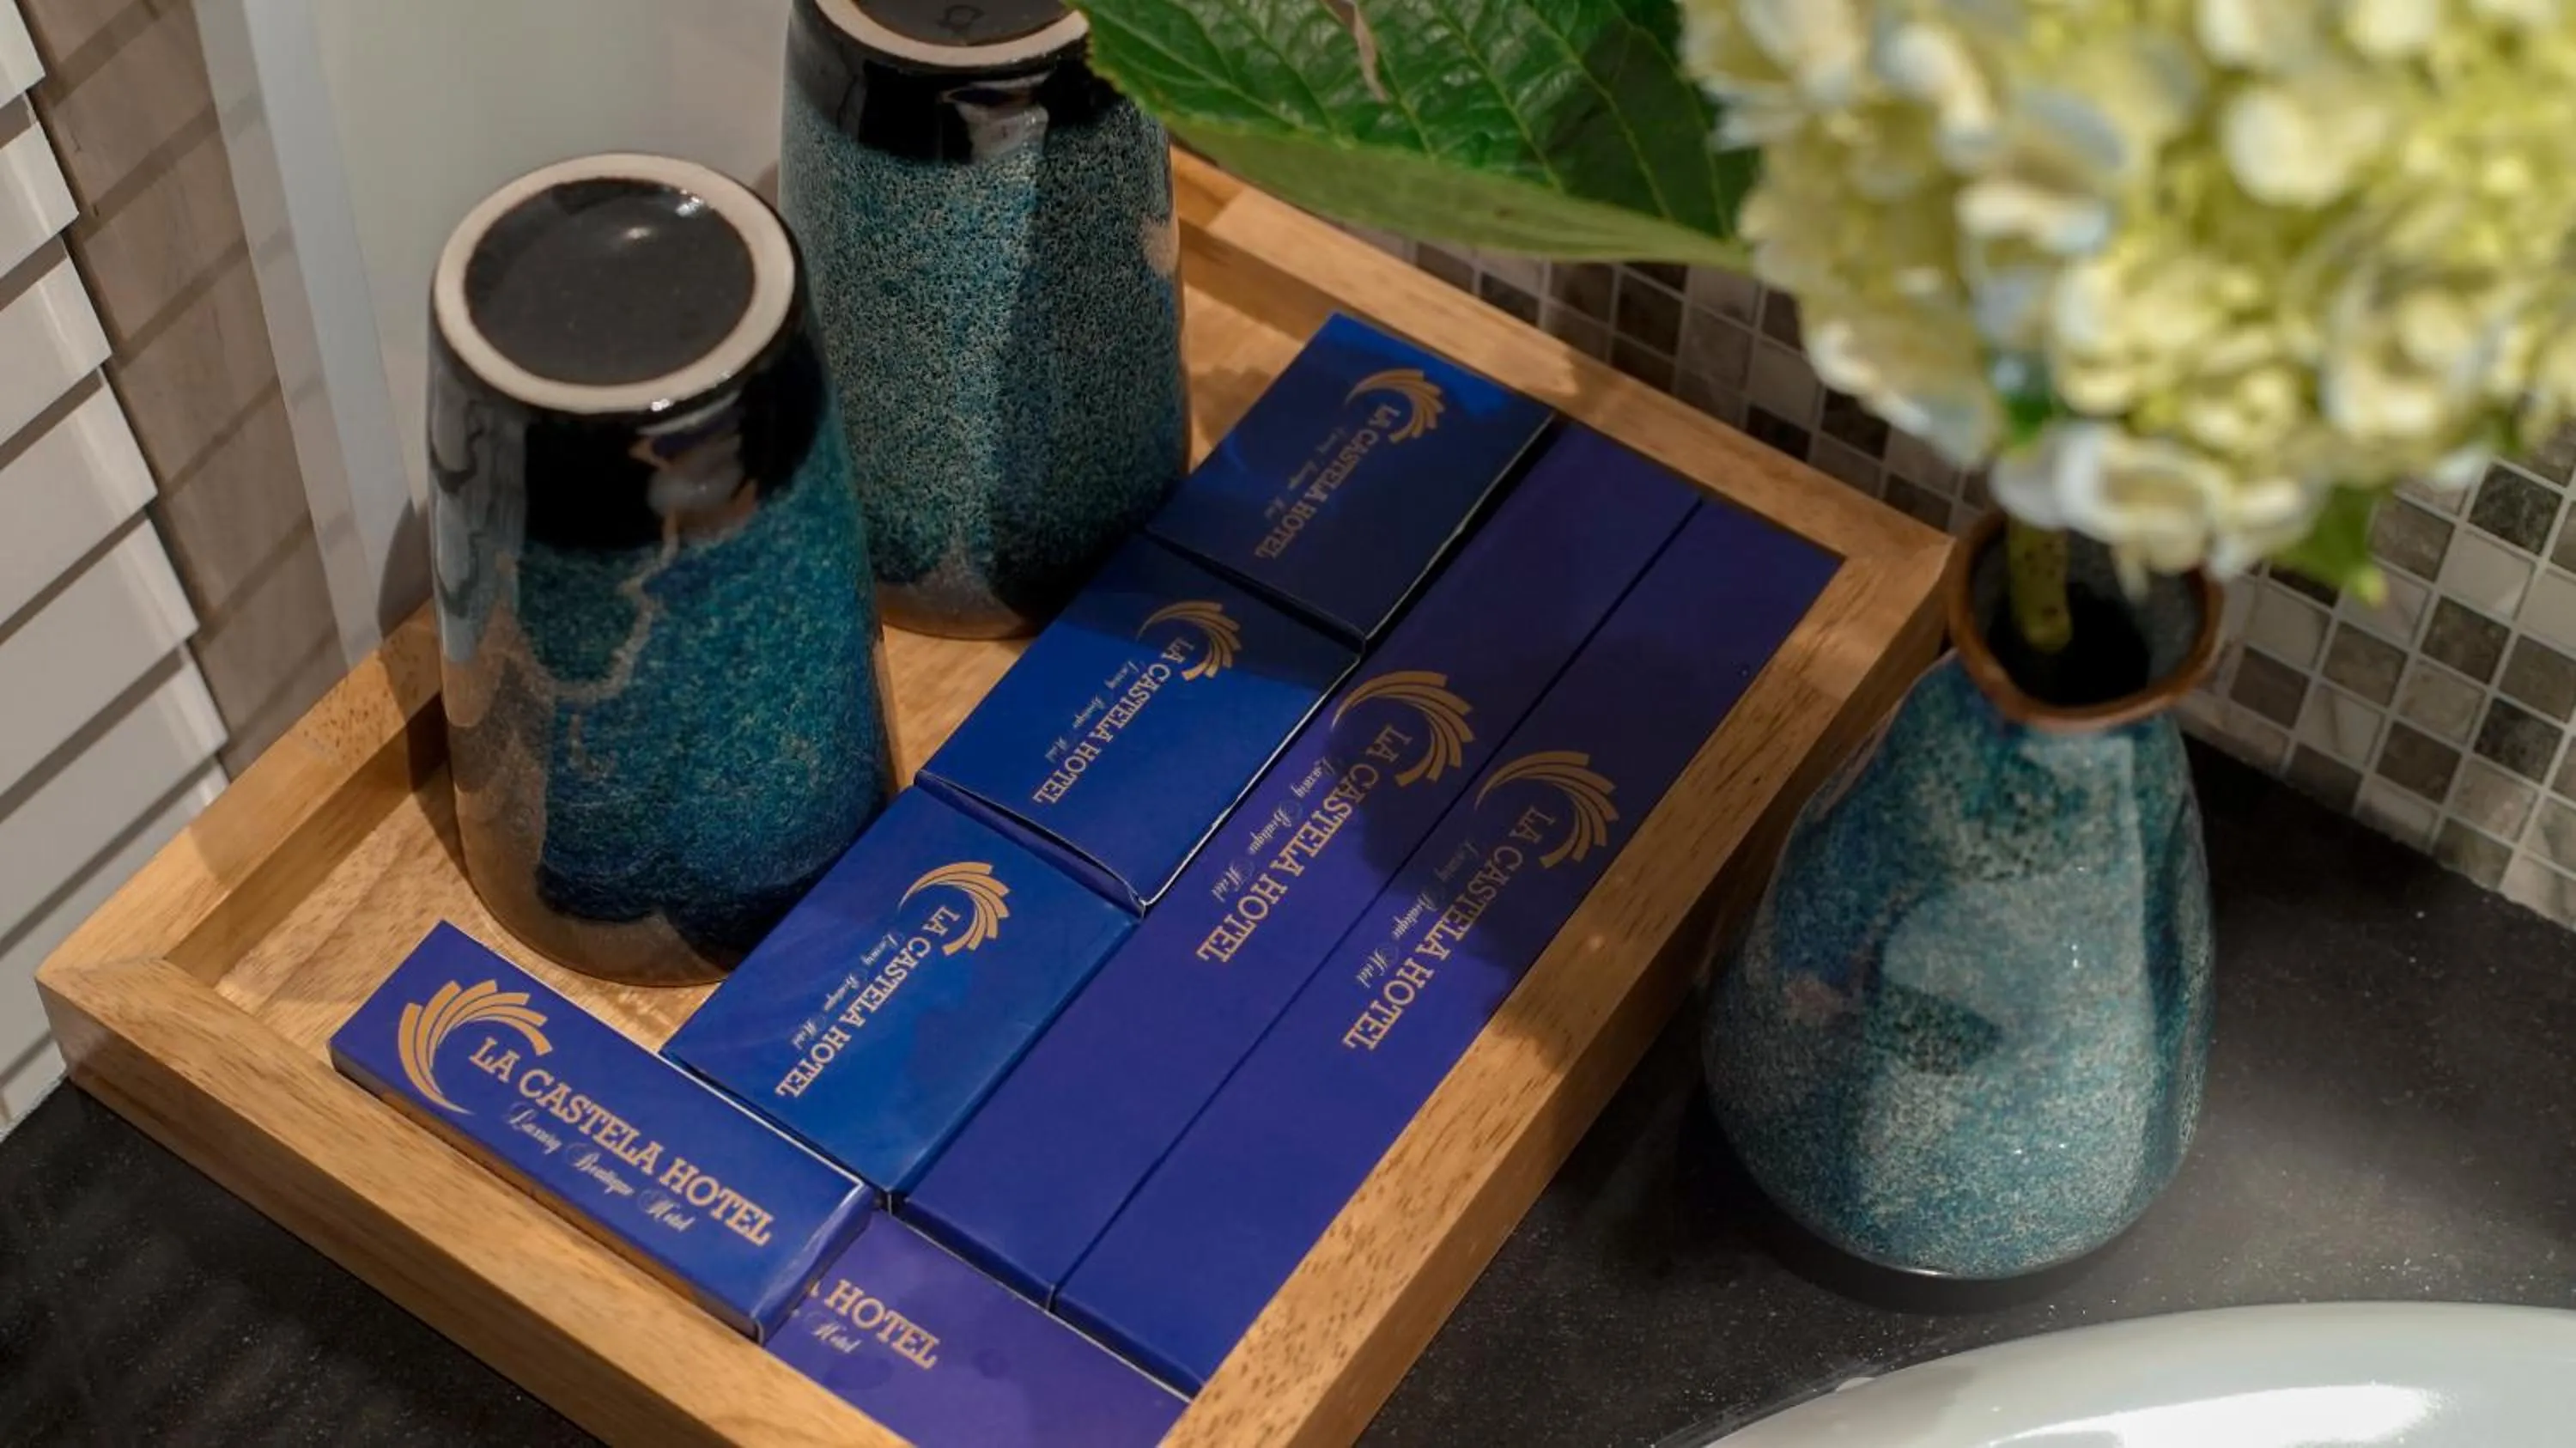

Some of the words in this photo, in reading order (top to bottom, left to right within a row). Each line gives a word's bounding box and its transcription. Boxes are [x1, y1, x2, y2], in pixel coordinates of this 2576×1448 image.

[1368, 401, 1400, 429] LA
[1304, 429, 1379, 502] CASTELA
[1255, 501, 1317, 559] HOTEL
[1161, 636, 1194, 664] LA
[1088, 663, 1171, 743] CASTELA
[1032, 740, 1102, 804] HOTEL
[1365, 723, 1413, 763] LA
[1269, 762, 1380, 878] CASTELA
[1509, 805, 1556, 844] LA
[922, 905, 962, 937] LA
[1194, 873, 1289, 963] HOTEL
[1414, 845, 1523, 961] CASTELA
[838, 936, 931, 1028] CASTELA
[1341, 958, 1435, 1051] HOTEL
[774, 1025, 853, 1098] HOTEL
[468, 1037, 519, 1084] LA
[517, 1068, 665, 1176] CASTELA
[659, 1163, 776, 1247] HOTEL
[823, 1278, 940, 1370] HOTEL
